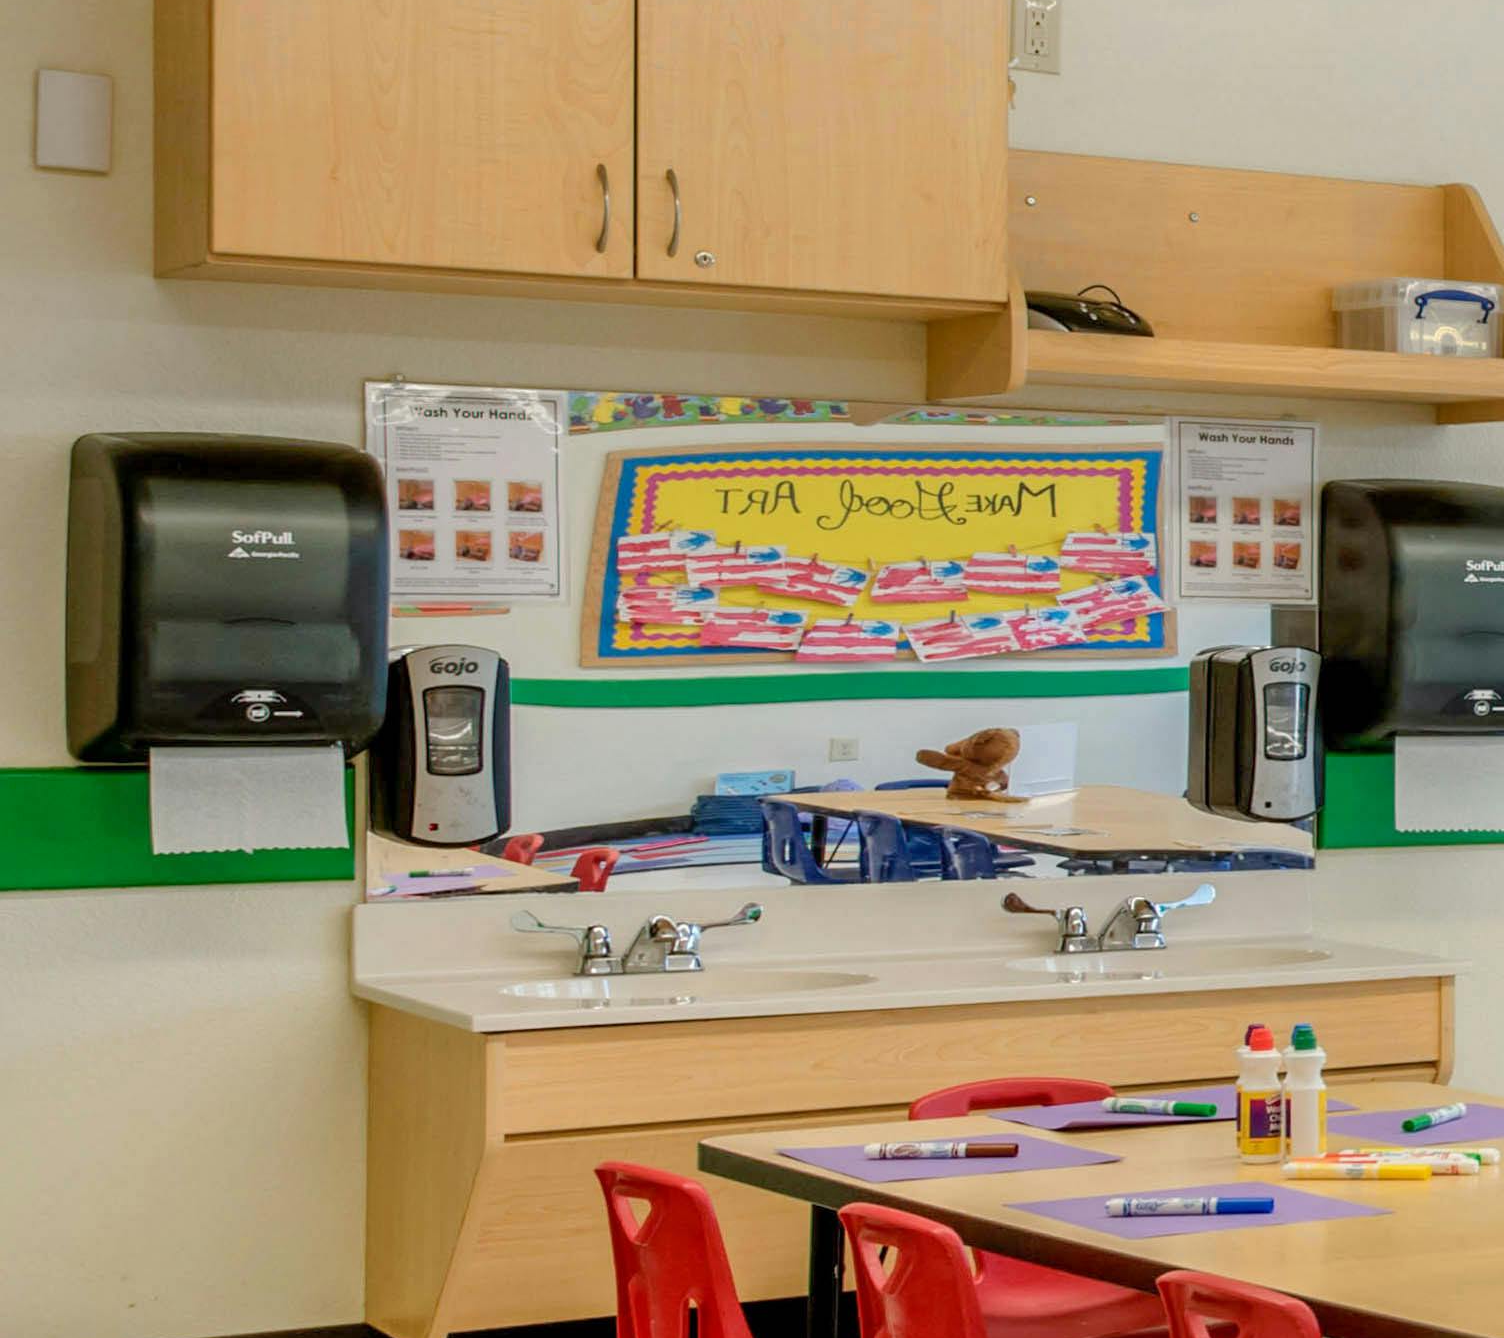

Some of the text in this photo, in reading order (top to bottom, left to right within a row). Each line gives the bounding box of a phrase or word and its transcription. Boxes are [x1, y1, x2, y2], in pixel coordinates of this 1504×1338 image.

[453, 408, 484, 420] Your
[1199, 433, 1295, 446] Wash Your Hands
[232, 530, 296, 545] SofPull
[430, 656, 479, 677] GOJO
